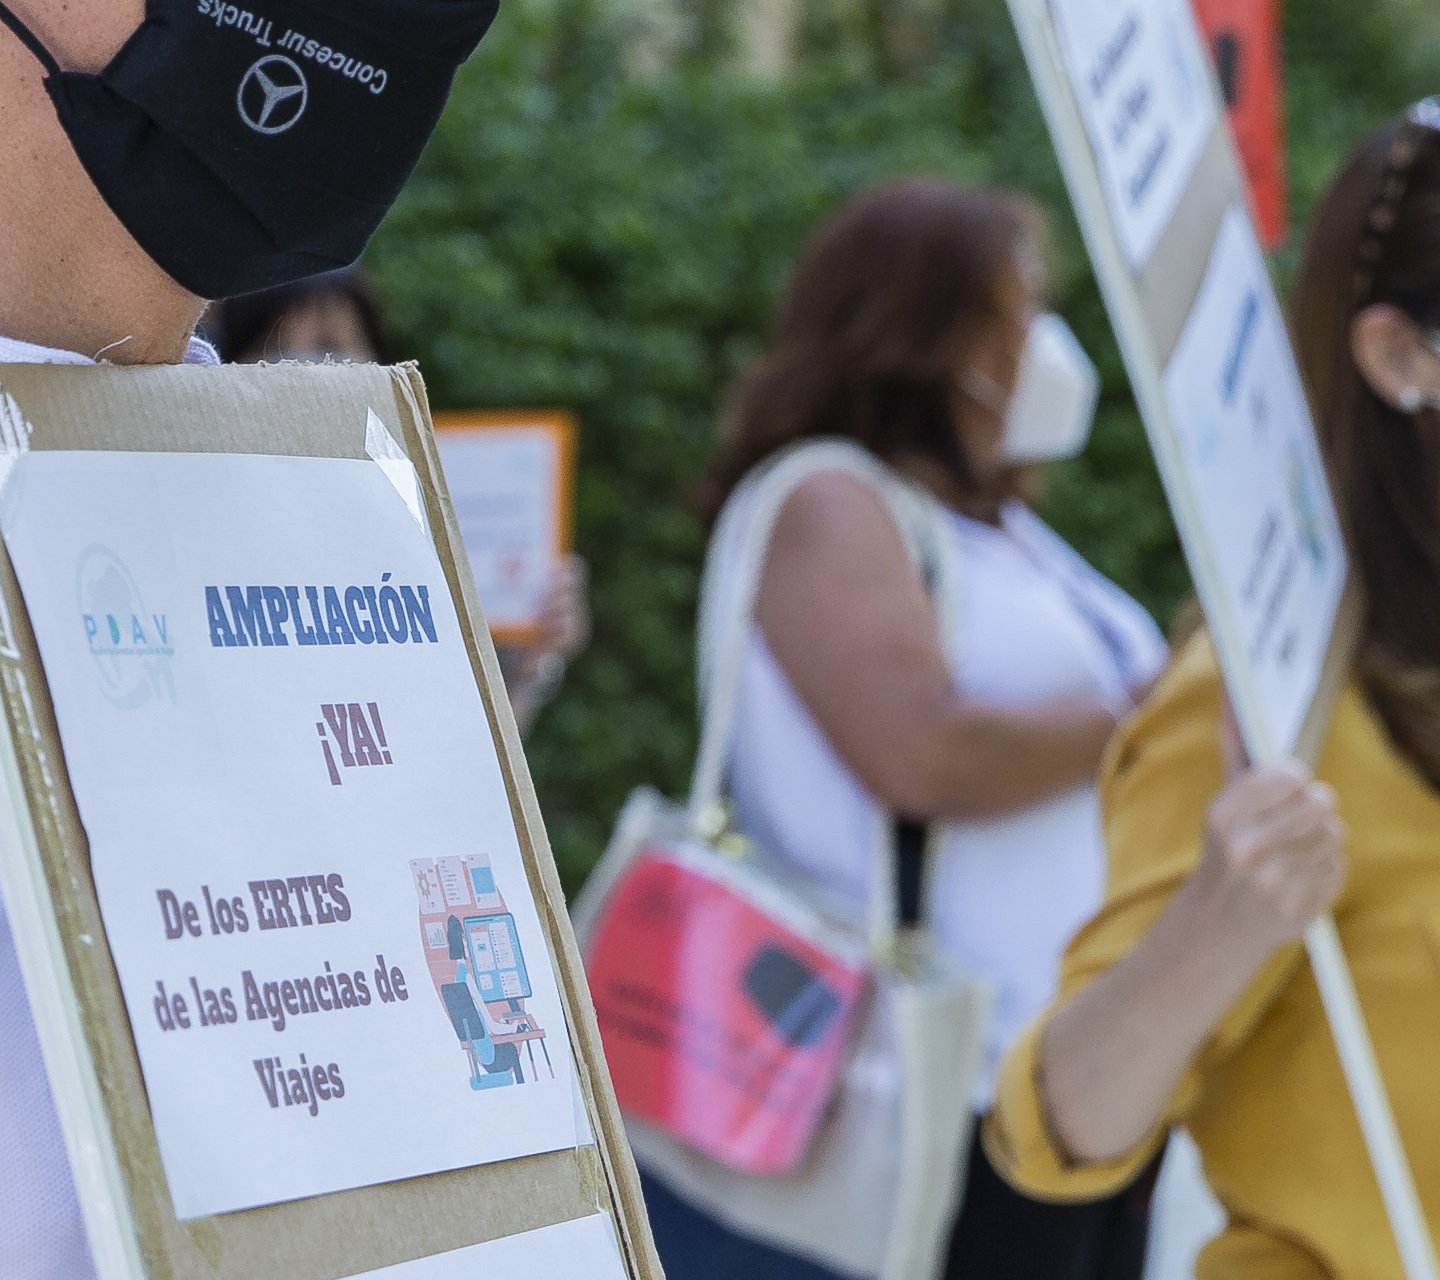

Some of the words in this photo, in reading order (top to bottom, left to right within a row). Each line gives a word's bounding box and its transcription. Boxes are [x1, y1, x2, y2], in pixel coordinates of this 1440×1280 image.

[277, 29, 388, 95] Concesur
[205, 572, 437, 647] AMPLIACIÓN
[316, 702, 393, 786] ¡YA!
[157, 888, 201, 940] De
[201, 884, 249, 935] los
[248, 873, 352, 931] ERTES
[153, 980, 191, 1031] de
[190, 977, 238, 1027] las
[242, 961, 370, 1032] Agencias
[372, 954, 409, 1004] de
[253, 1054, 345, 1117] Viajes
